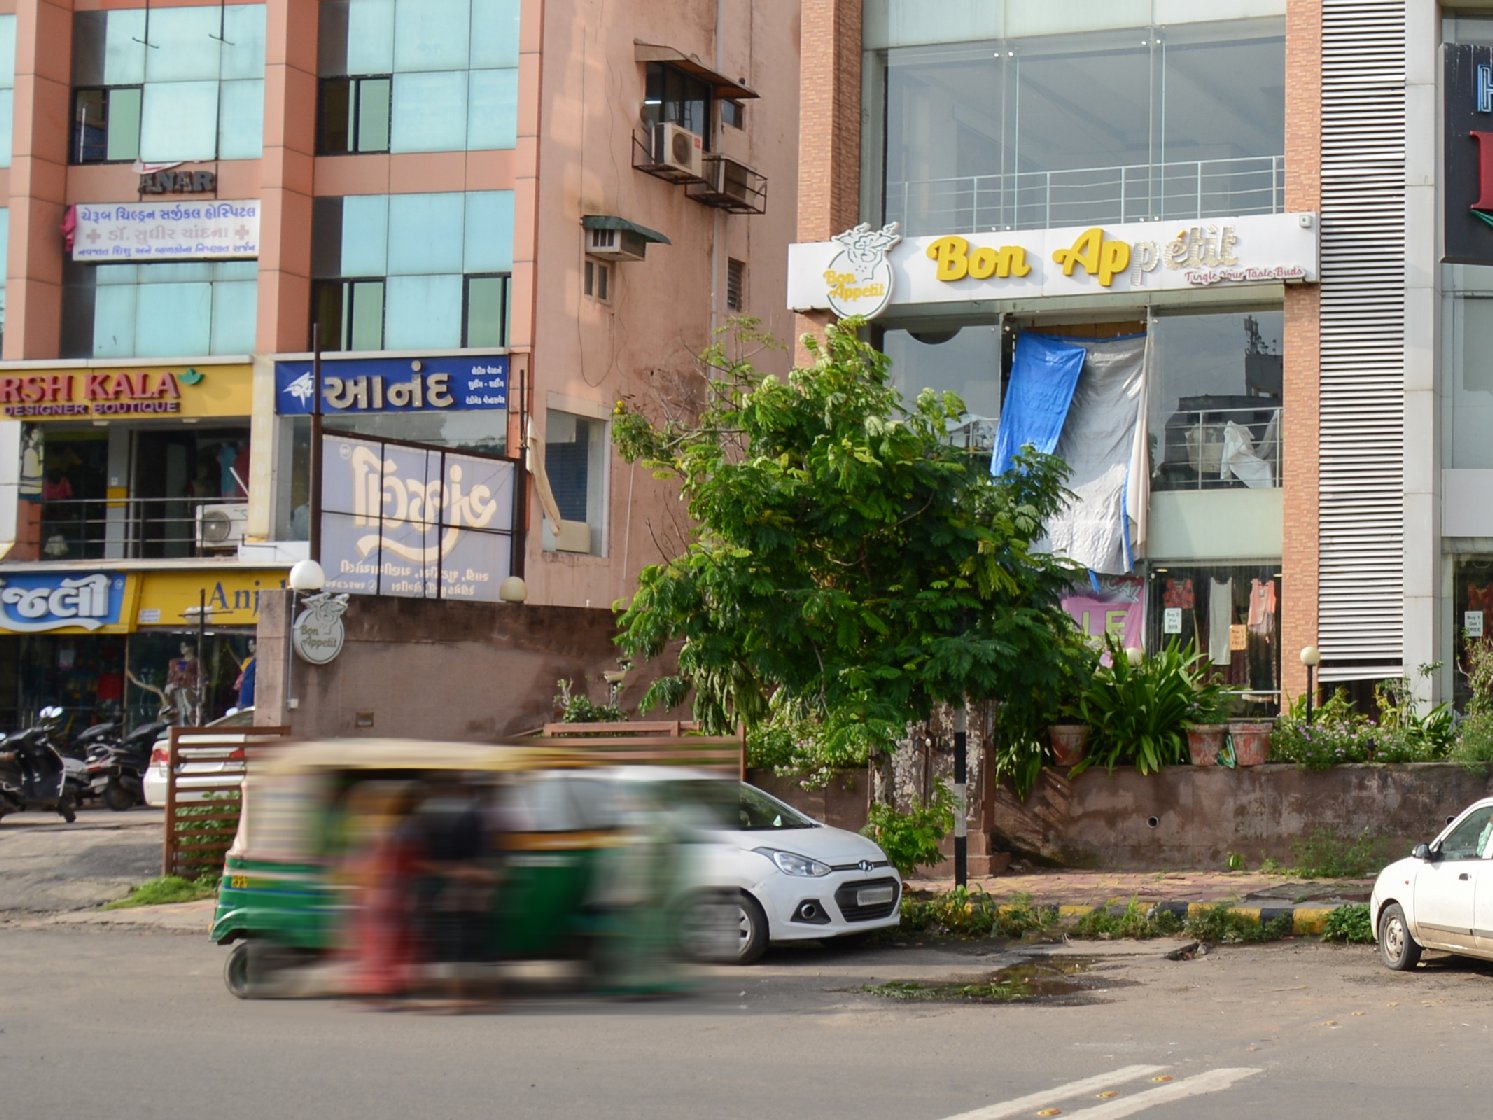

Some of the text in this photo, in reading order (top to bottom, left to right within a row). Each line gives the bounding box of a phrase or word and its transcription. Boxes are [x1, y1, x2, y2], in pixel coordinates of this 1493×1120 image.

[926, 235, 1032, 281] Bon
[823, 270, 856, 285] Bon
[84, 371, 181, 401] KALA
[322, 360, 454, 410] આનંદ
[4, 401, 180, 417] DESIGNER BOUTIQUE
[0, 573, 110, 631] જલી
